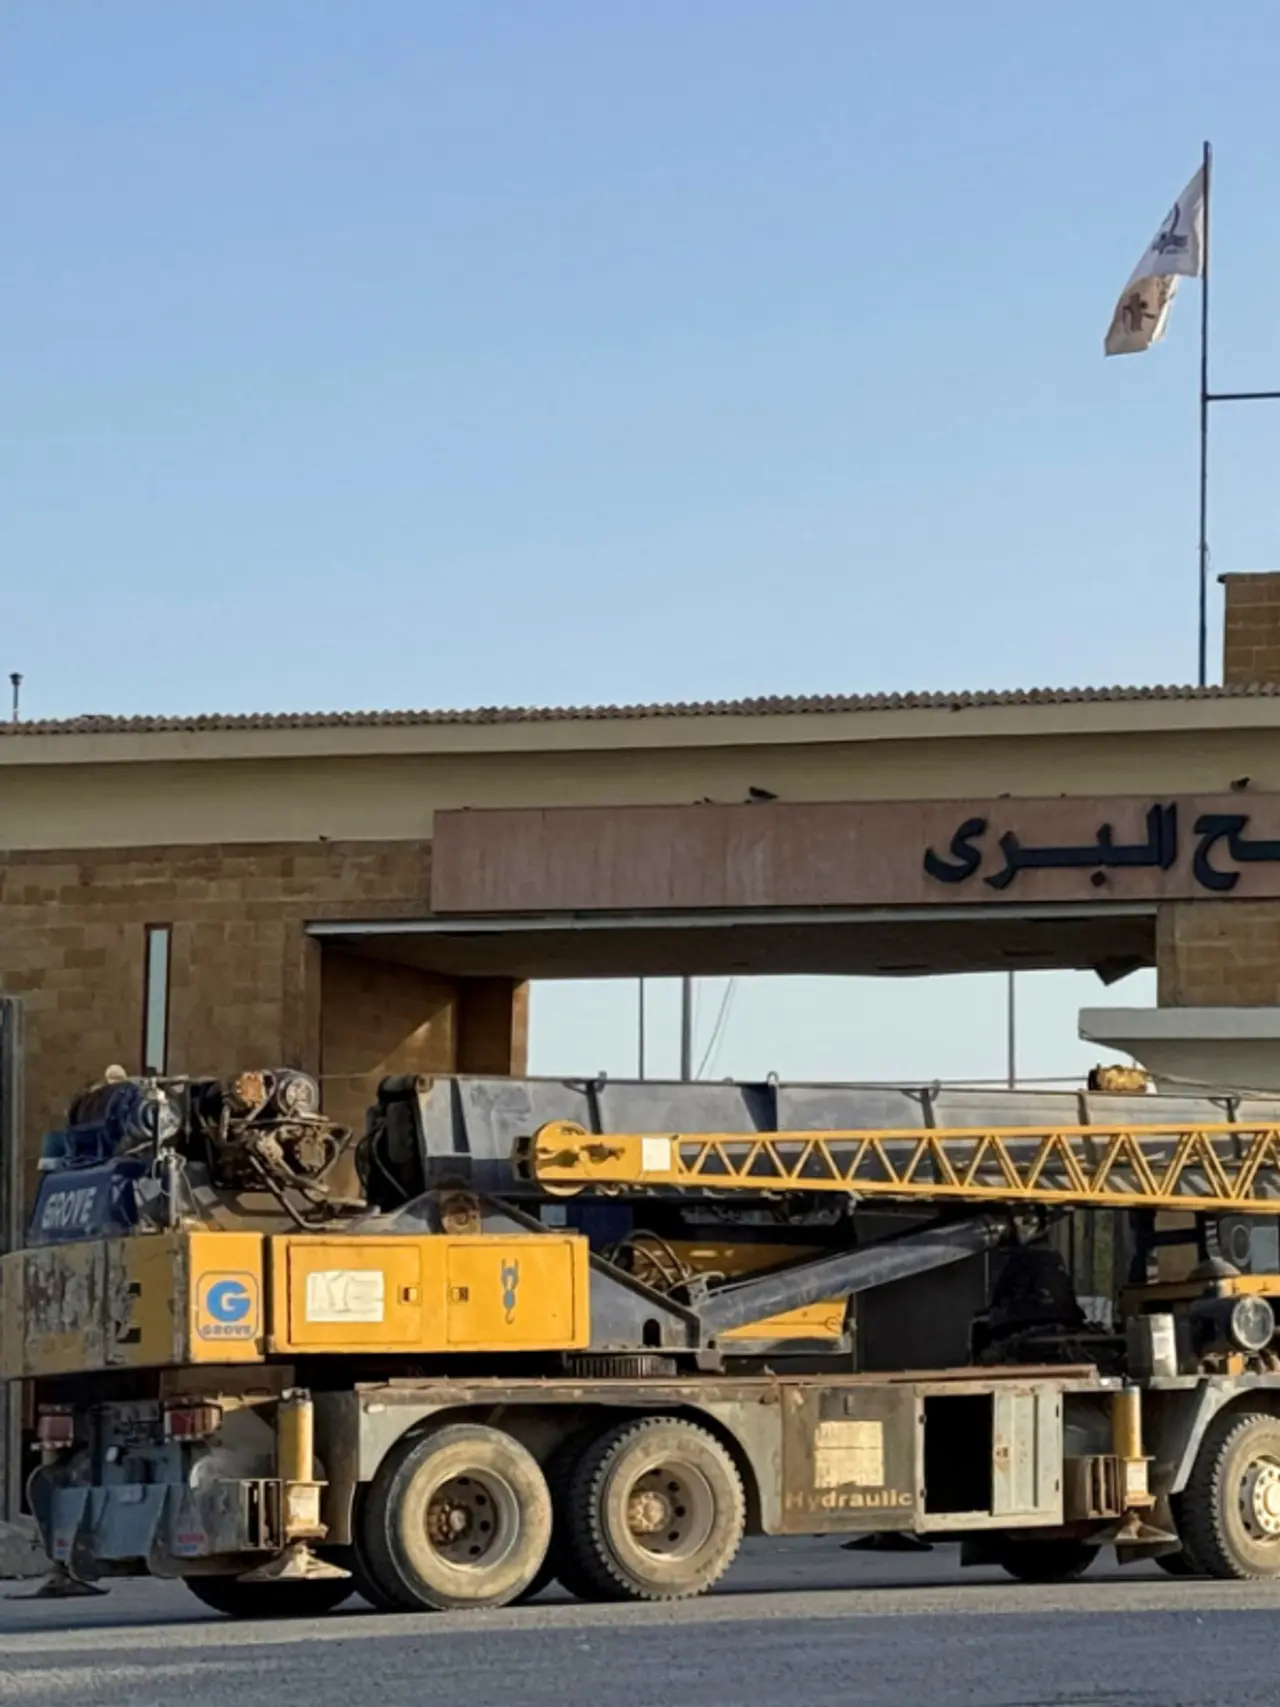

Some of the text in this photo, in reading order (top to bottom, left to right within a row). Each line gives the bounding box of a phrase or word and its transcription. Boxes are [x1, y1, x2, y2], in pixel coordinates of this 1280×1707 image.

[923, 801, 1179, 889] البرى
[206, 1281, 250, 1322] G
[784, 1489, 914, 1512] Hydraulic
